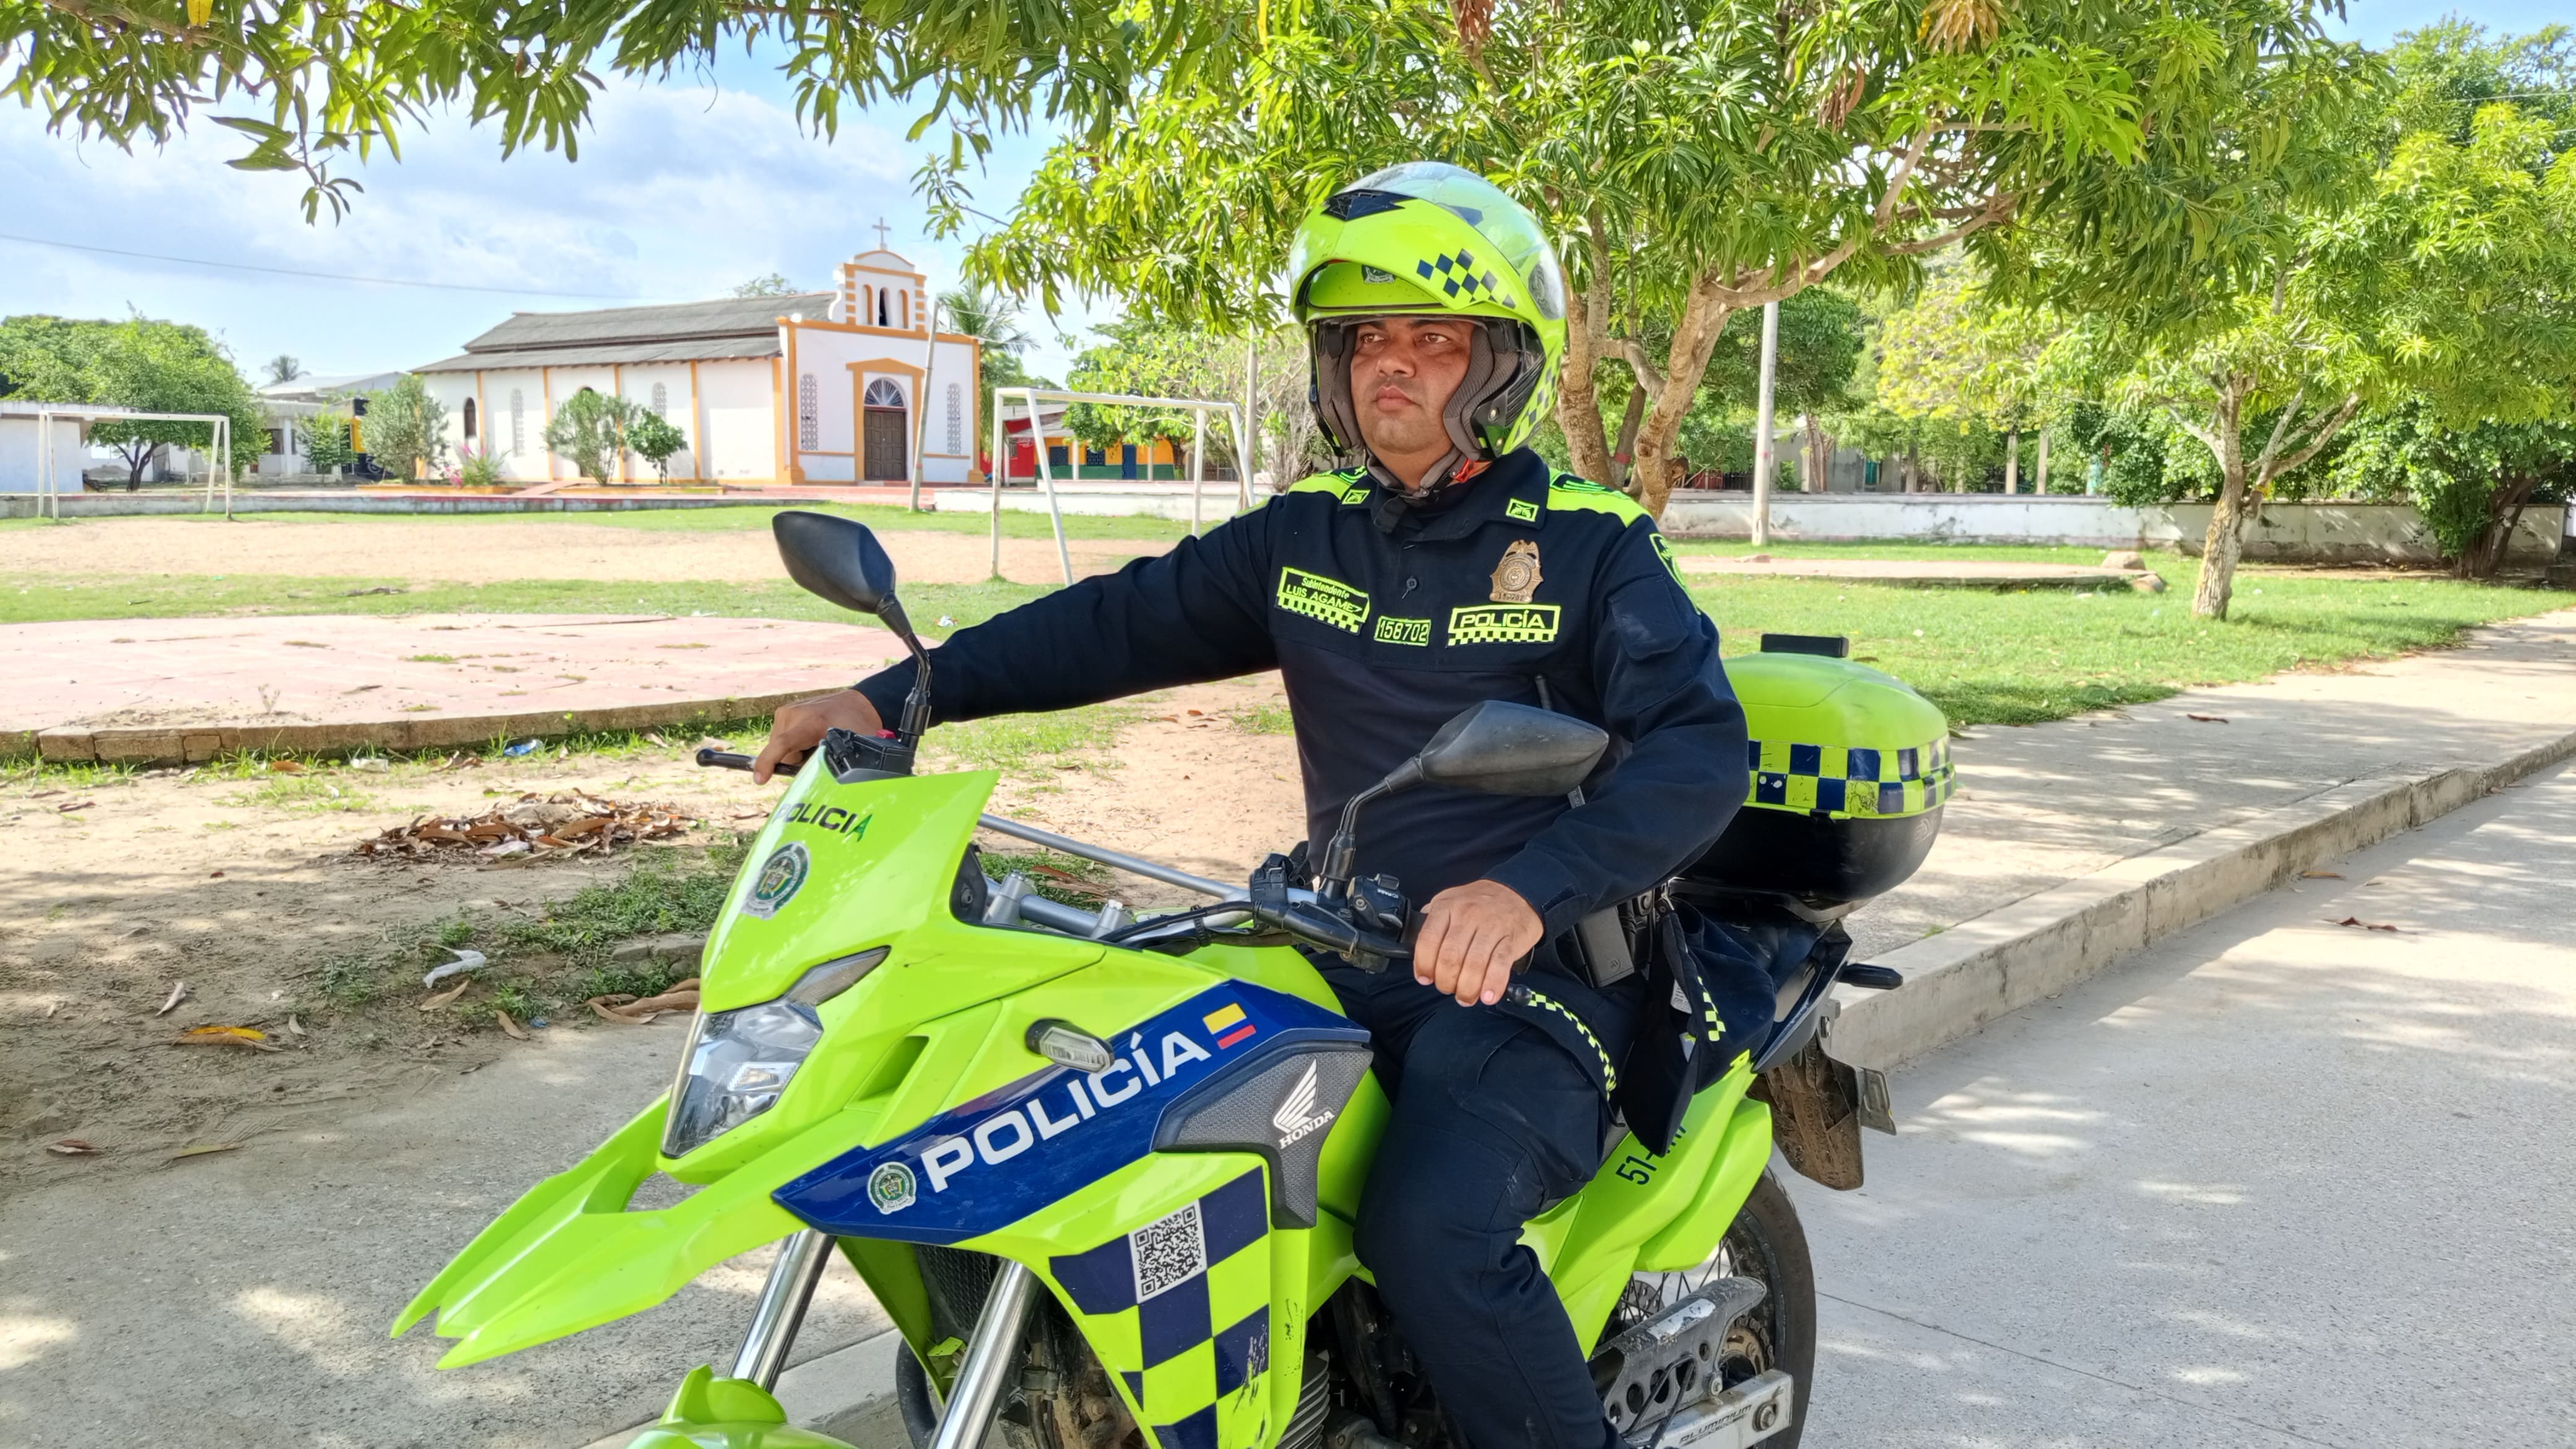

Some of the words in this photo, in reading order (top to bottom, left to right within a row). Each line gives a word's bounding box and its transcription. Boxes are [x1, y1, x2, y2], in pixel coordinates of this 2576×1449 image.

[1286, 584, 1307, 598] LUIS
[1379, 620, 1429, 642] 158702
[1460, 609, 1546, 629] POLICÍA
[772, 803, 873, 843] POLICIA
[920, 1030, 1212, 1193] POLICÍA
[1278, 1110, 1335, 1150] HONDA
